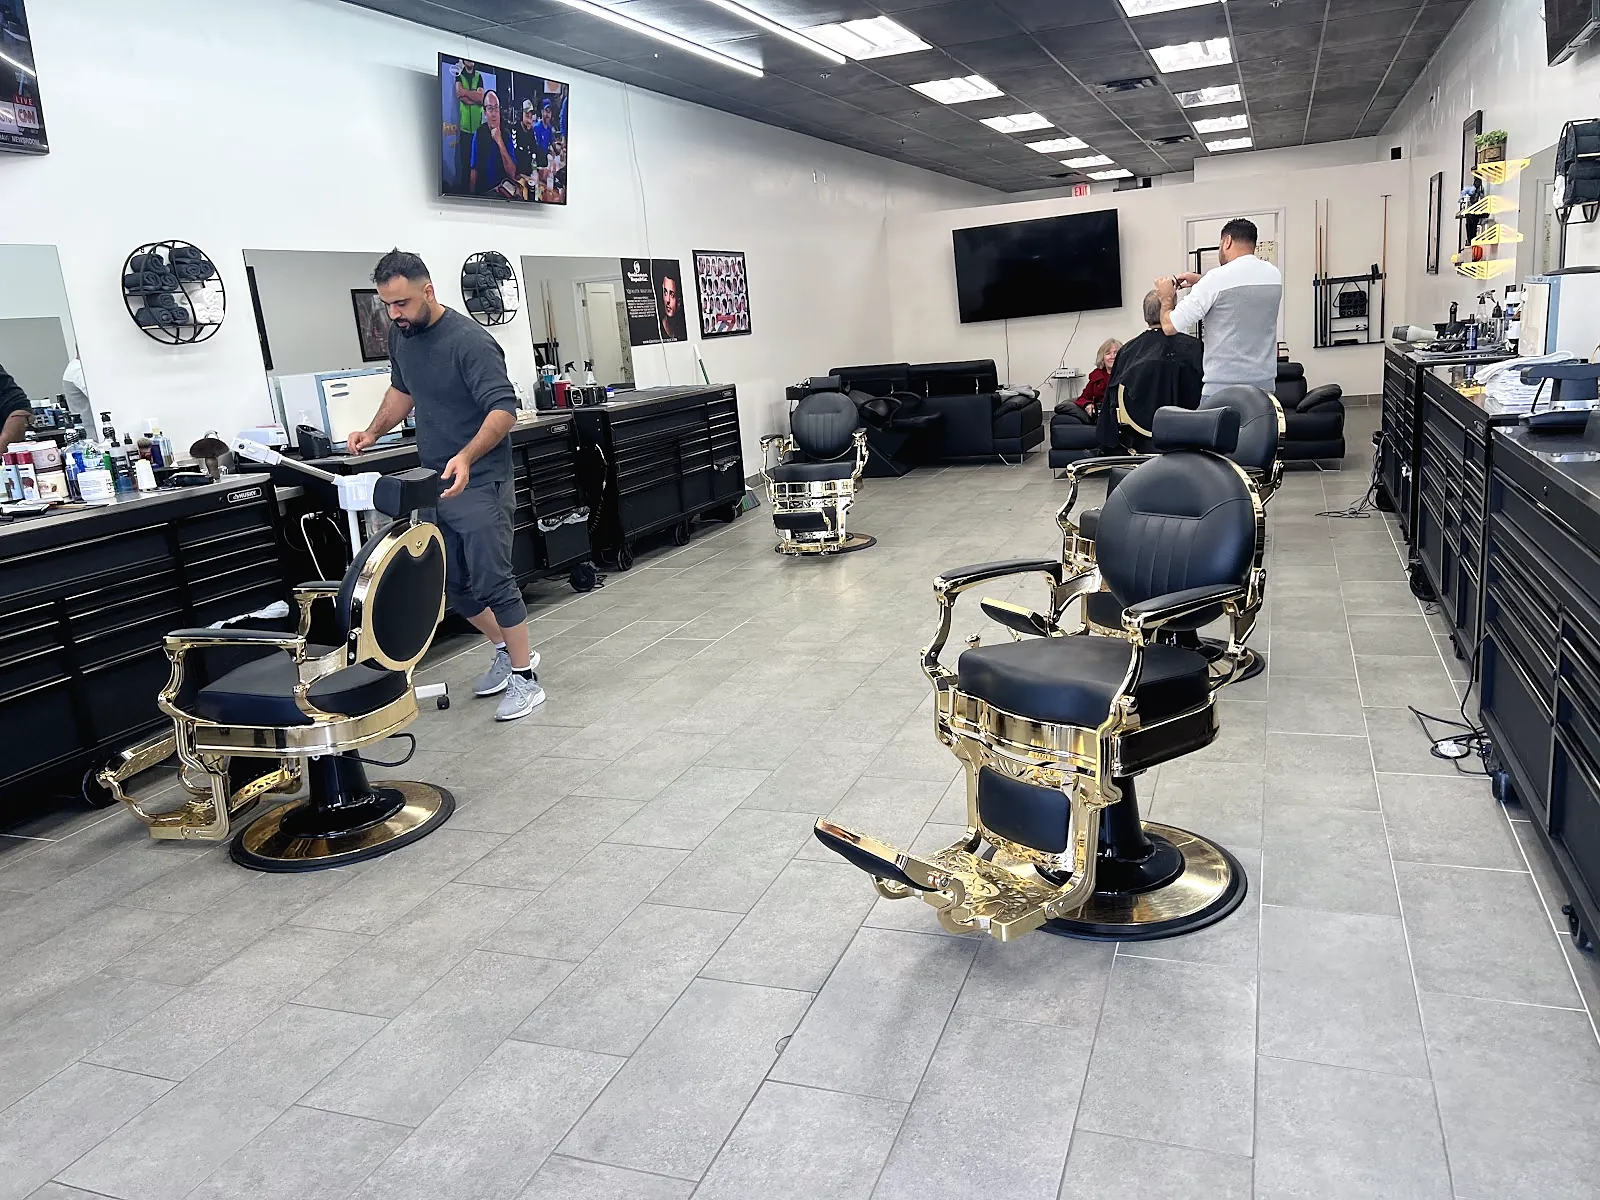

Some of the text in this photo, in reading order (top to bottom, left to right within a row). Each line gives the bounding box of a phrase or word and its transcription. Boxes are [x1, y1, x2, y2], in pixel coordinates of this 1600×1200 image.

[15, 95, 33, 106] LIVE
[18, 109, 36, 125] CNN
[11, 135, 40, 146] NEWSROOM
[1074, 185, 1088, 197] EXIT
